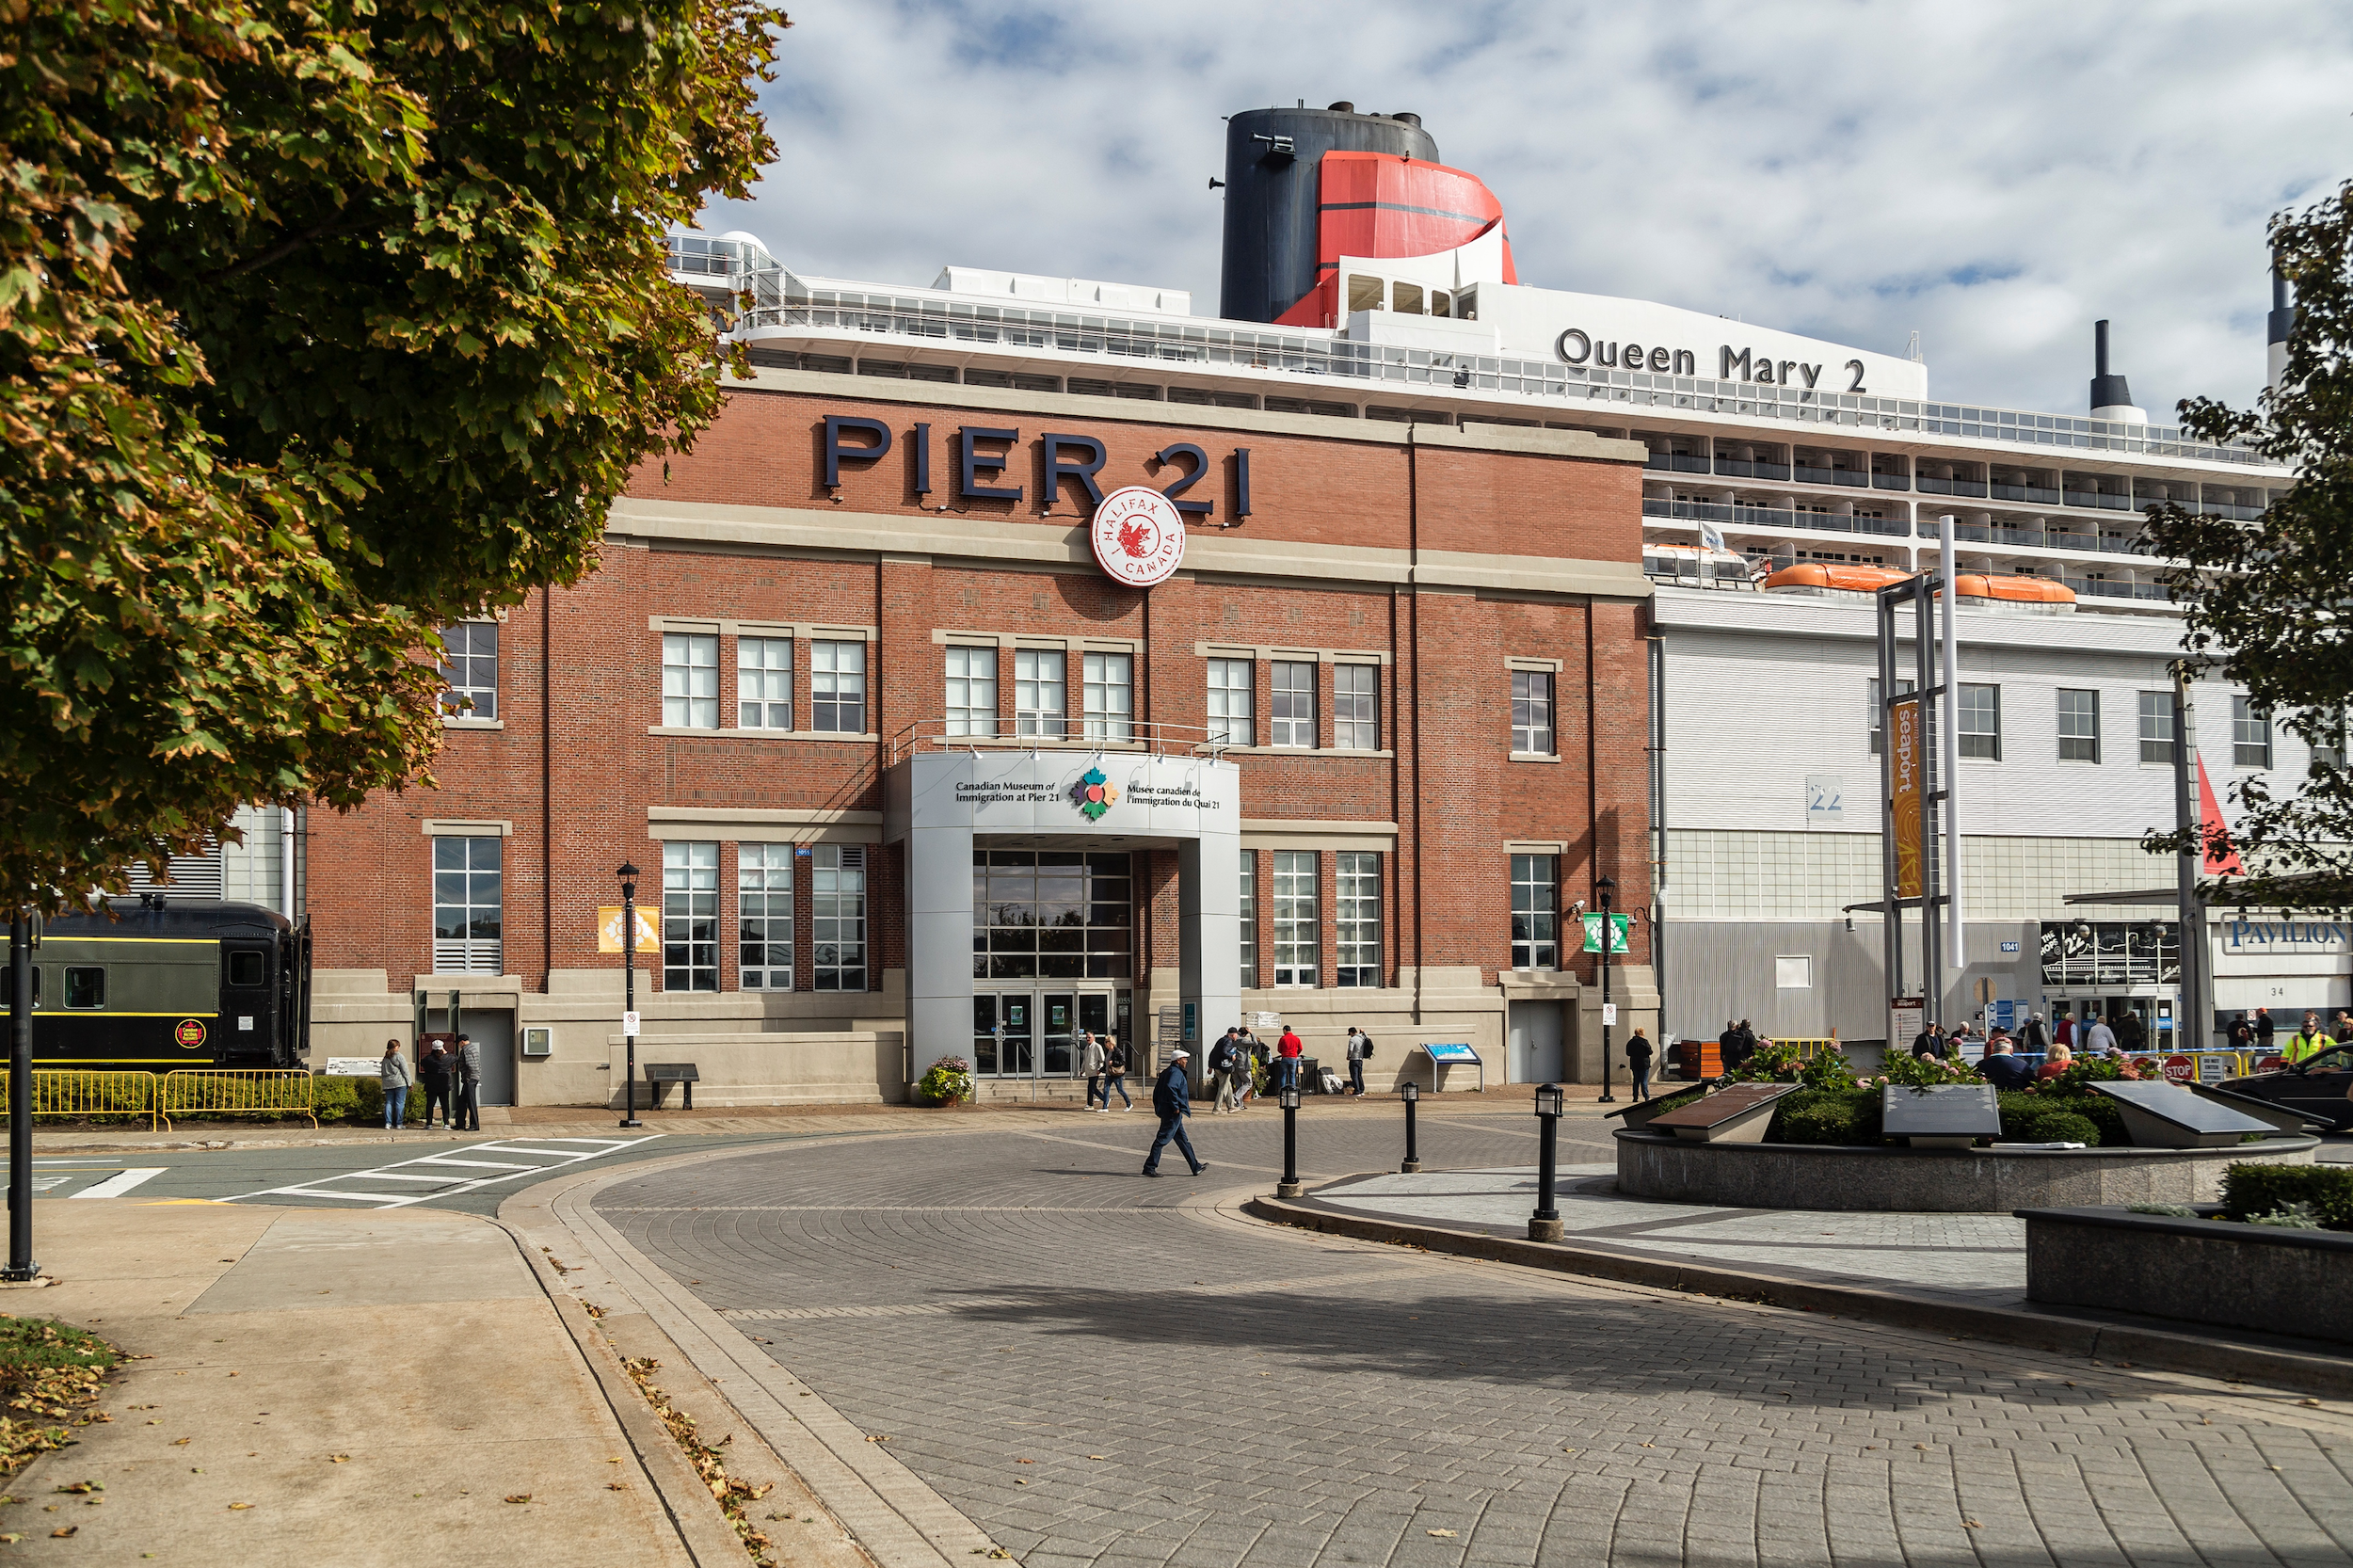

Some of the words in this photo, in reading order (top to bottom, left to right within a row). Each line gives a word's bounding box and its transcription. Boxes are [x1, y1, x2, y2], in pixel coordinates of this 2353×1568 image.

[1557, 328, 1695, 376] Queen
[1720, 344, 1823, 402] Mary
[1845, 358, 1867, 394] 2
[822, 414, 1107, 505] PIER
[1154, 442, 1252, 517] 21
[1103, 498, 1159, 541] HALIFAX
[1125, 533, 1176, 575] CANADA
[1897, 708, 1913, 793] seaport
[955, 781, 1000, 791] Canadian
[1002, 781, 1044, 791] Museum
[1045, 781, 1056, 791] of
[1127, 784, 1155, 794] Musée
[1156, 786, 1192, 796] canadien
[1192, 788, 1201, 797] de
[955, 792, 1014, 805] Immigration
[1016, 793, 1026, 802] at
[1028, 792, 1046, 802] Pier
[1048, 792, 1060, 802] 21
[1127, 794, 1180, 808] l'immigration
[1182, 797, 1193, 807] du
[1193, 798, 1211, 809] Quai
[1211, 800, 1220, 809] 21
[1810, 784, 1842, 811] 22
[2041, 929, 2056, 943] THE
[2064, 932, 2086, 955] 22
[2230, 920, 2348, 948] PAVILION
[2001, 942, 2019, 952] 1041
[1116, 997, 1131, 1005] 1055
[2165, 1064, 2191, 1077] STOP
